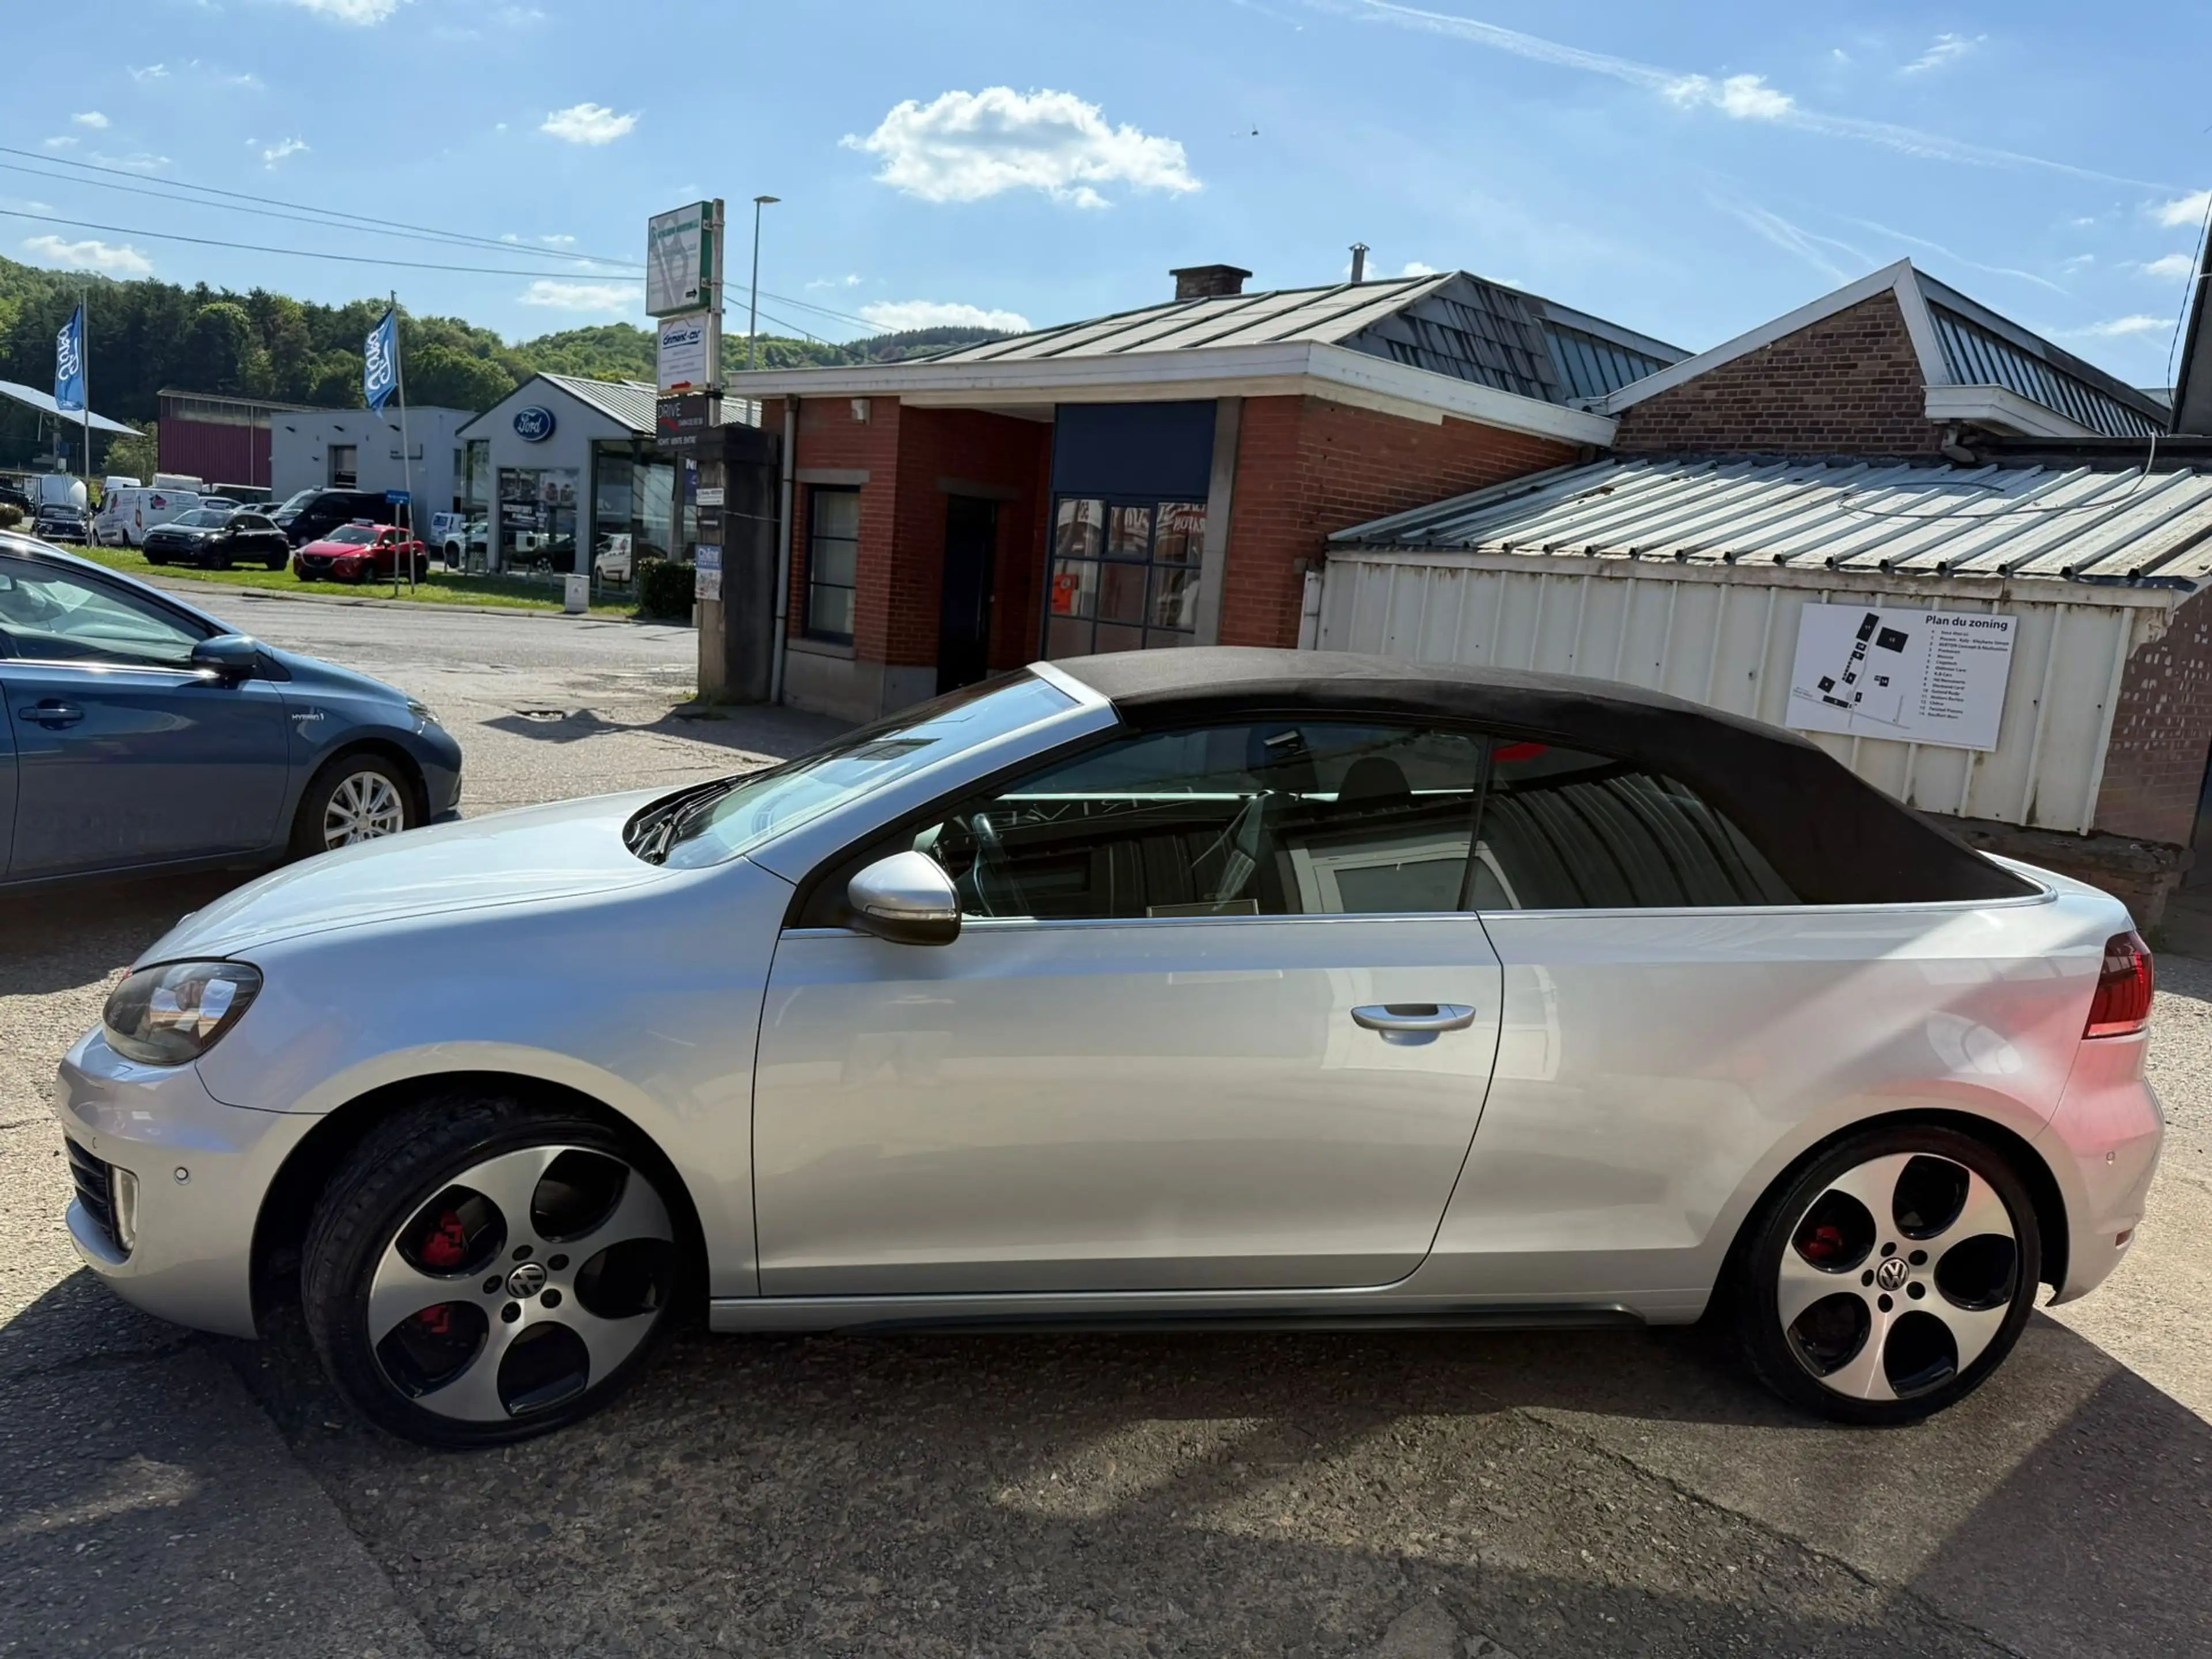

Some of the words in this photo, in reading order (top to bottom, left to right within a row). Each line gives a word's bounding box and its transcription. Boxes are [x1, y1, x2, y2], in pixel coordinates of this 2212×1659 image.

[658, 403, 681, 419] DRIVE
[517, 411, 542, 433] Ford
[1926, 615, 1949, 626] Plan
[1952, 618, 1967, 627] du
[1968, 619, 2009, 632] zoning
